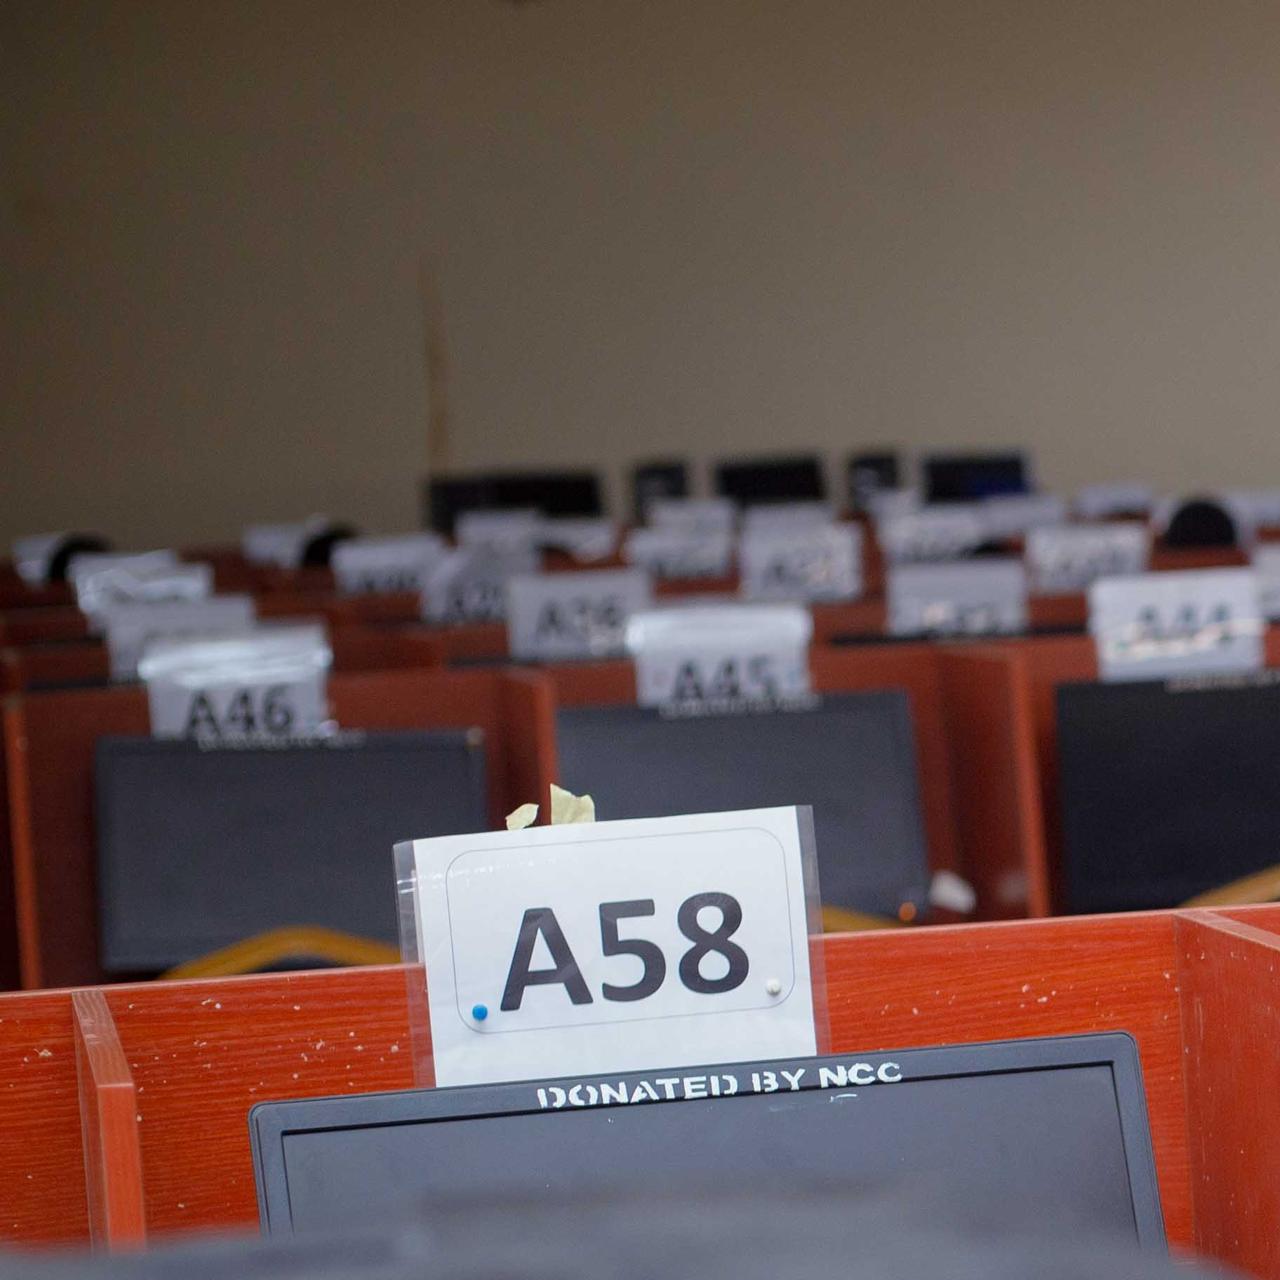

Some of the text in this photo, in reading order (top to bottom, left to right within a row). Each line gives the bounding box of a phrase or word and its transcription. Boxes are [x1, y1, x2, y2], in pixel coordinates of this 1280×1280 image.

[673, 654, 780, 700] A45
[184, 682, 293, 738] A46
[500, 891, 750, 1012] A58
[537, 1061, 903, 1110] DONATED BY NCC
